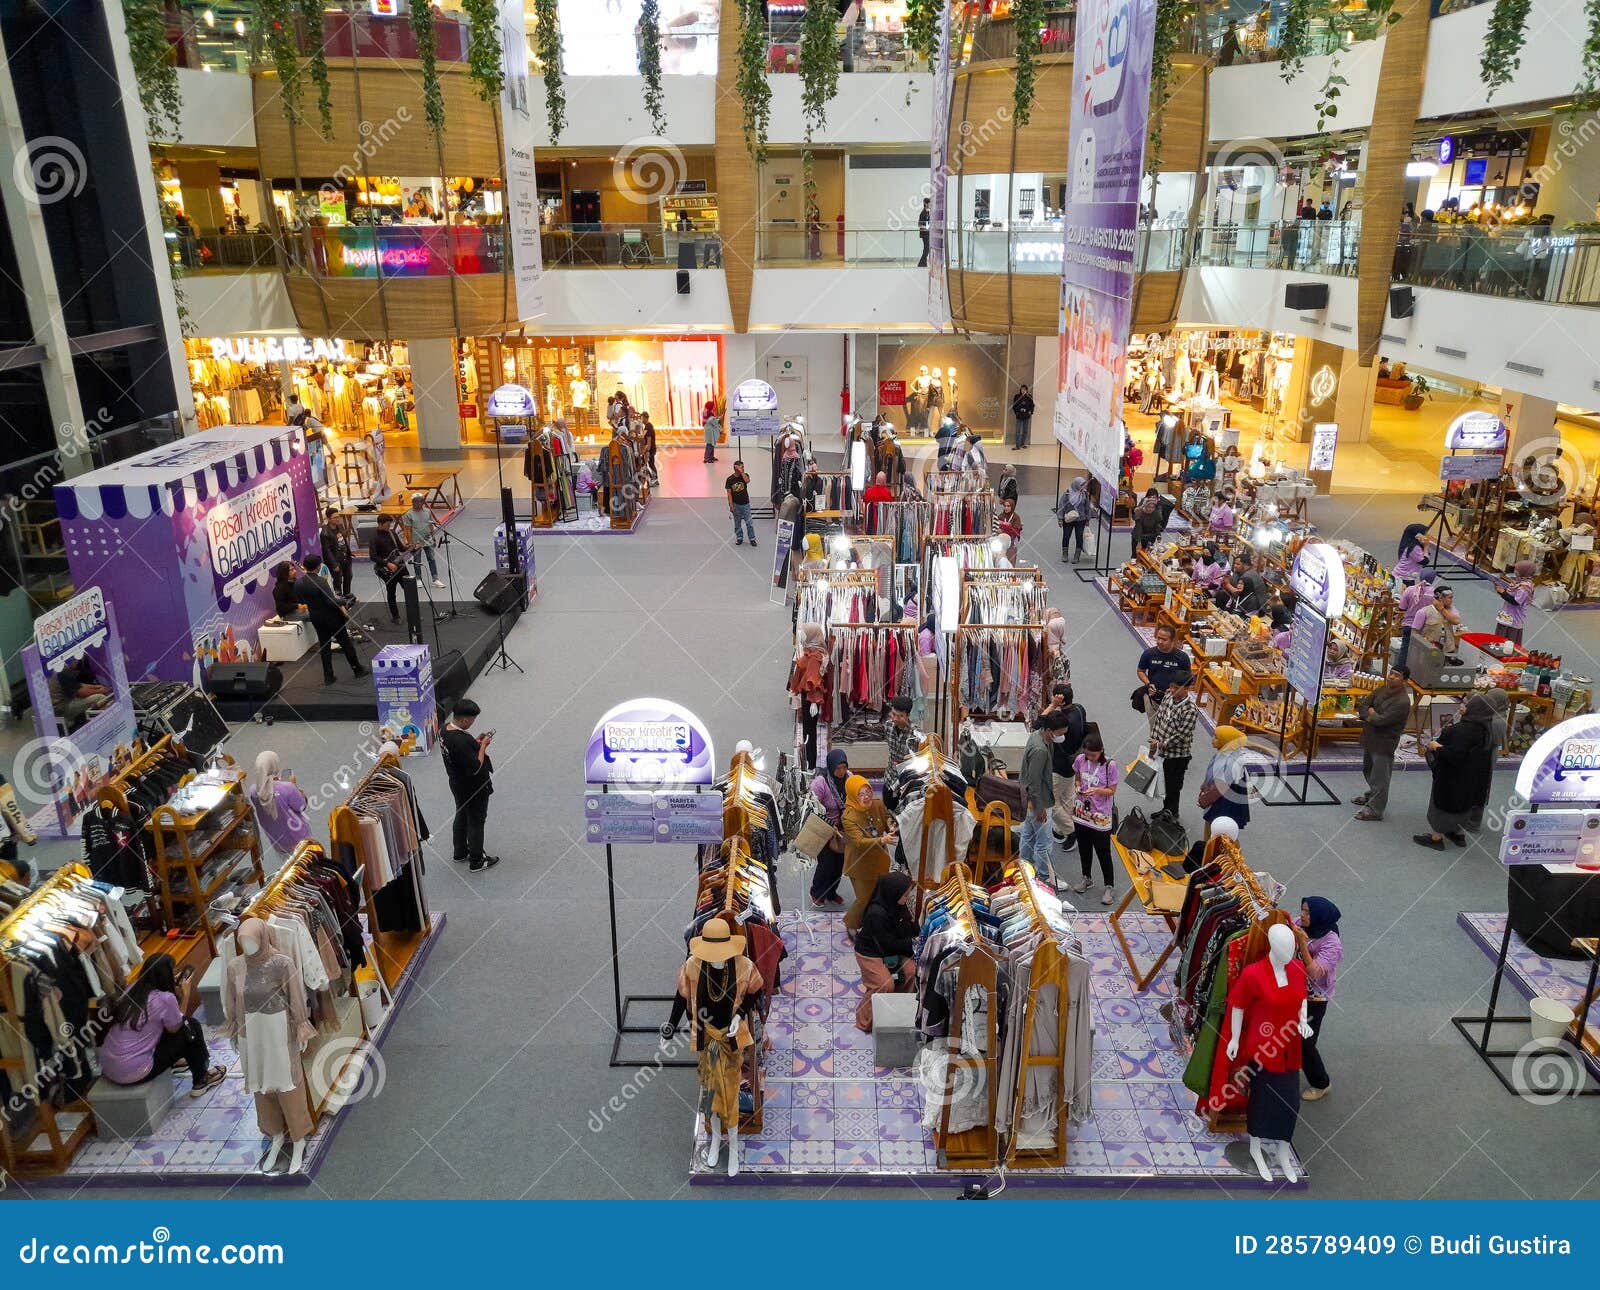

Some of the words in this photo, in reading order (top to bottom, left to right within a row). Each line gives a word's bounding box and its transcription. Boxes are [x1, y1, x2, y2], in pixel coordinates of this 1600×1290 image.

[210, 336, 347, 362] PULL&BEAR
[213, 511, 244, 545] Pasar
[244, 487, 279, 527] Kreatif
[217, 513, 283, 578] BANDUNG
[607, 725, 637, 737] Pasar
[639, 725, 674, 737] Kreatif
[1566, 743, 1595, 757] Pasar
